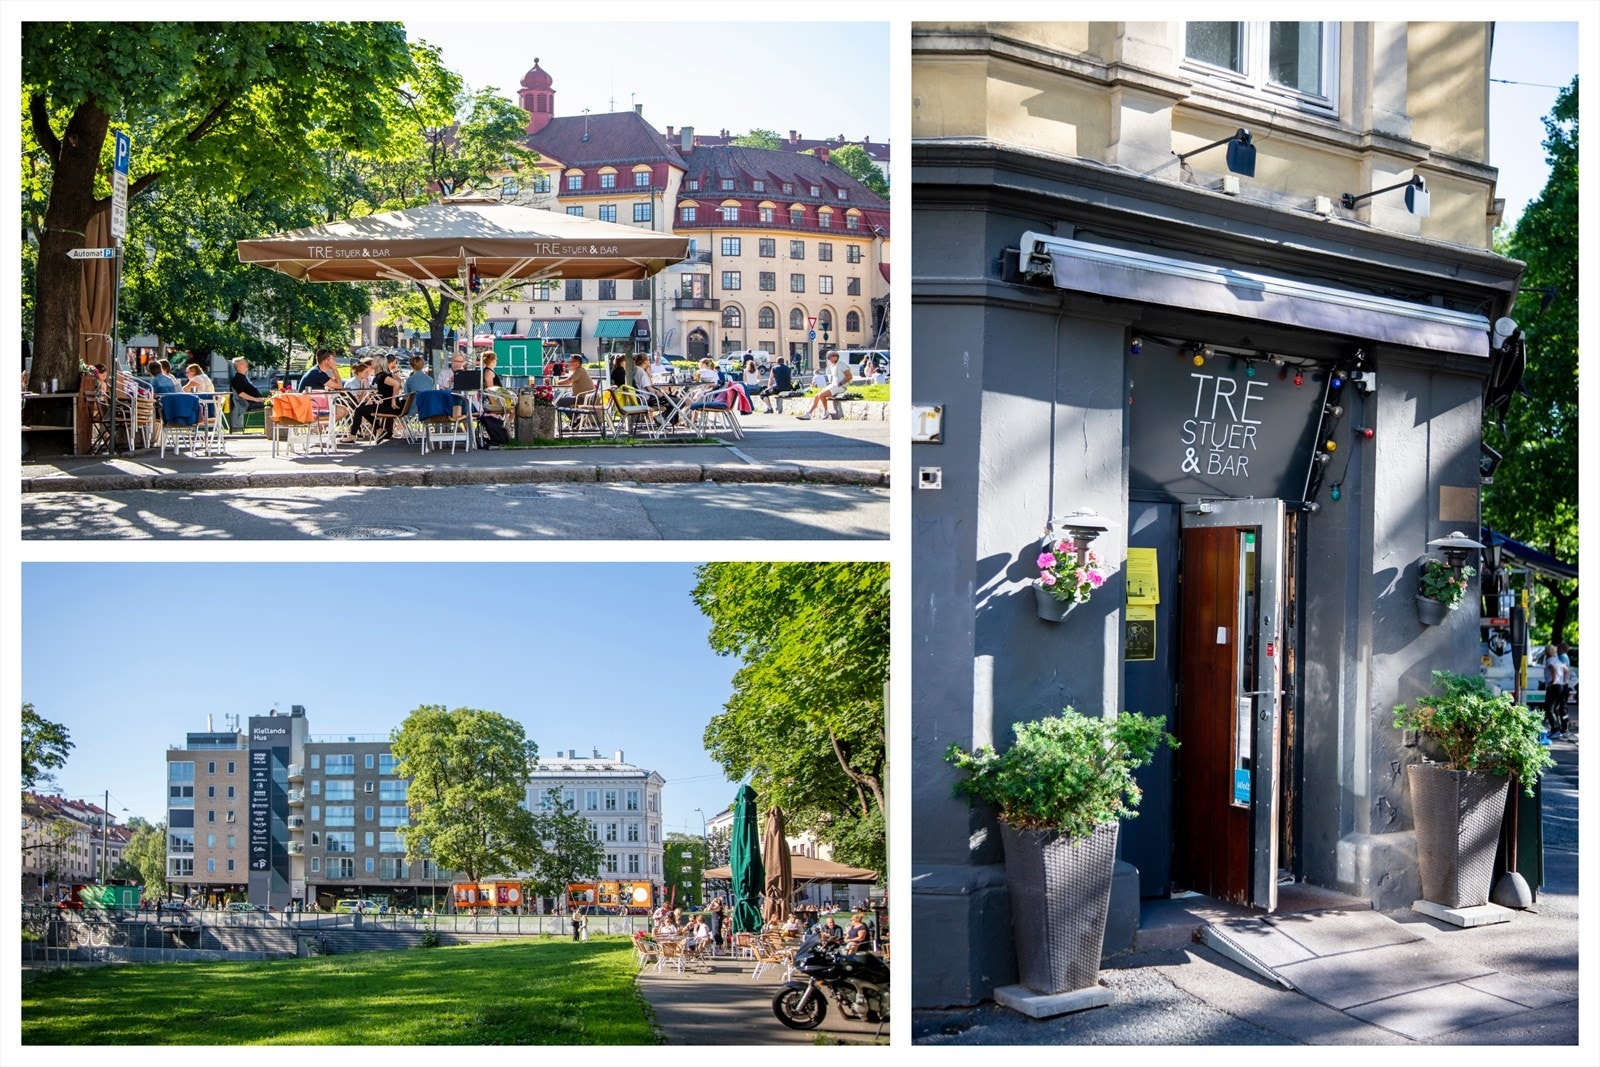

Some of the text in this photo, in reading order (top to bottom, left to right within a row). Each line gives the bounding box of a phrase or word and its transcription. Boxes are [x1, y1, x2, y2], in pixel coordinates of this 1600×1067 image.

[118, 137, 127, 167] P
[308, 246, 333, 259] TRE
[362, 248, 371, 257] &
[372, 248, 391, 257] BAR
[534, 242, 560, 255] TRE
[589, 244, 598, 254] &
[599, 245, 619, 254] BAR
[1190, 372, 1269, 425] TRE
[1181, 447, 1249, 477] & BAR
